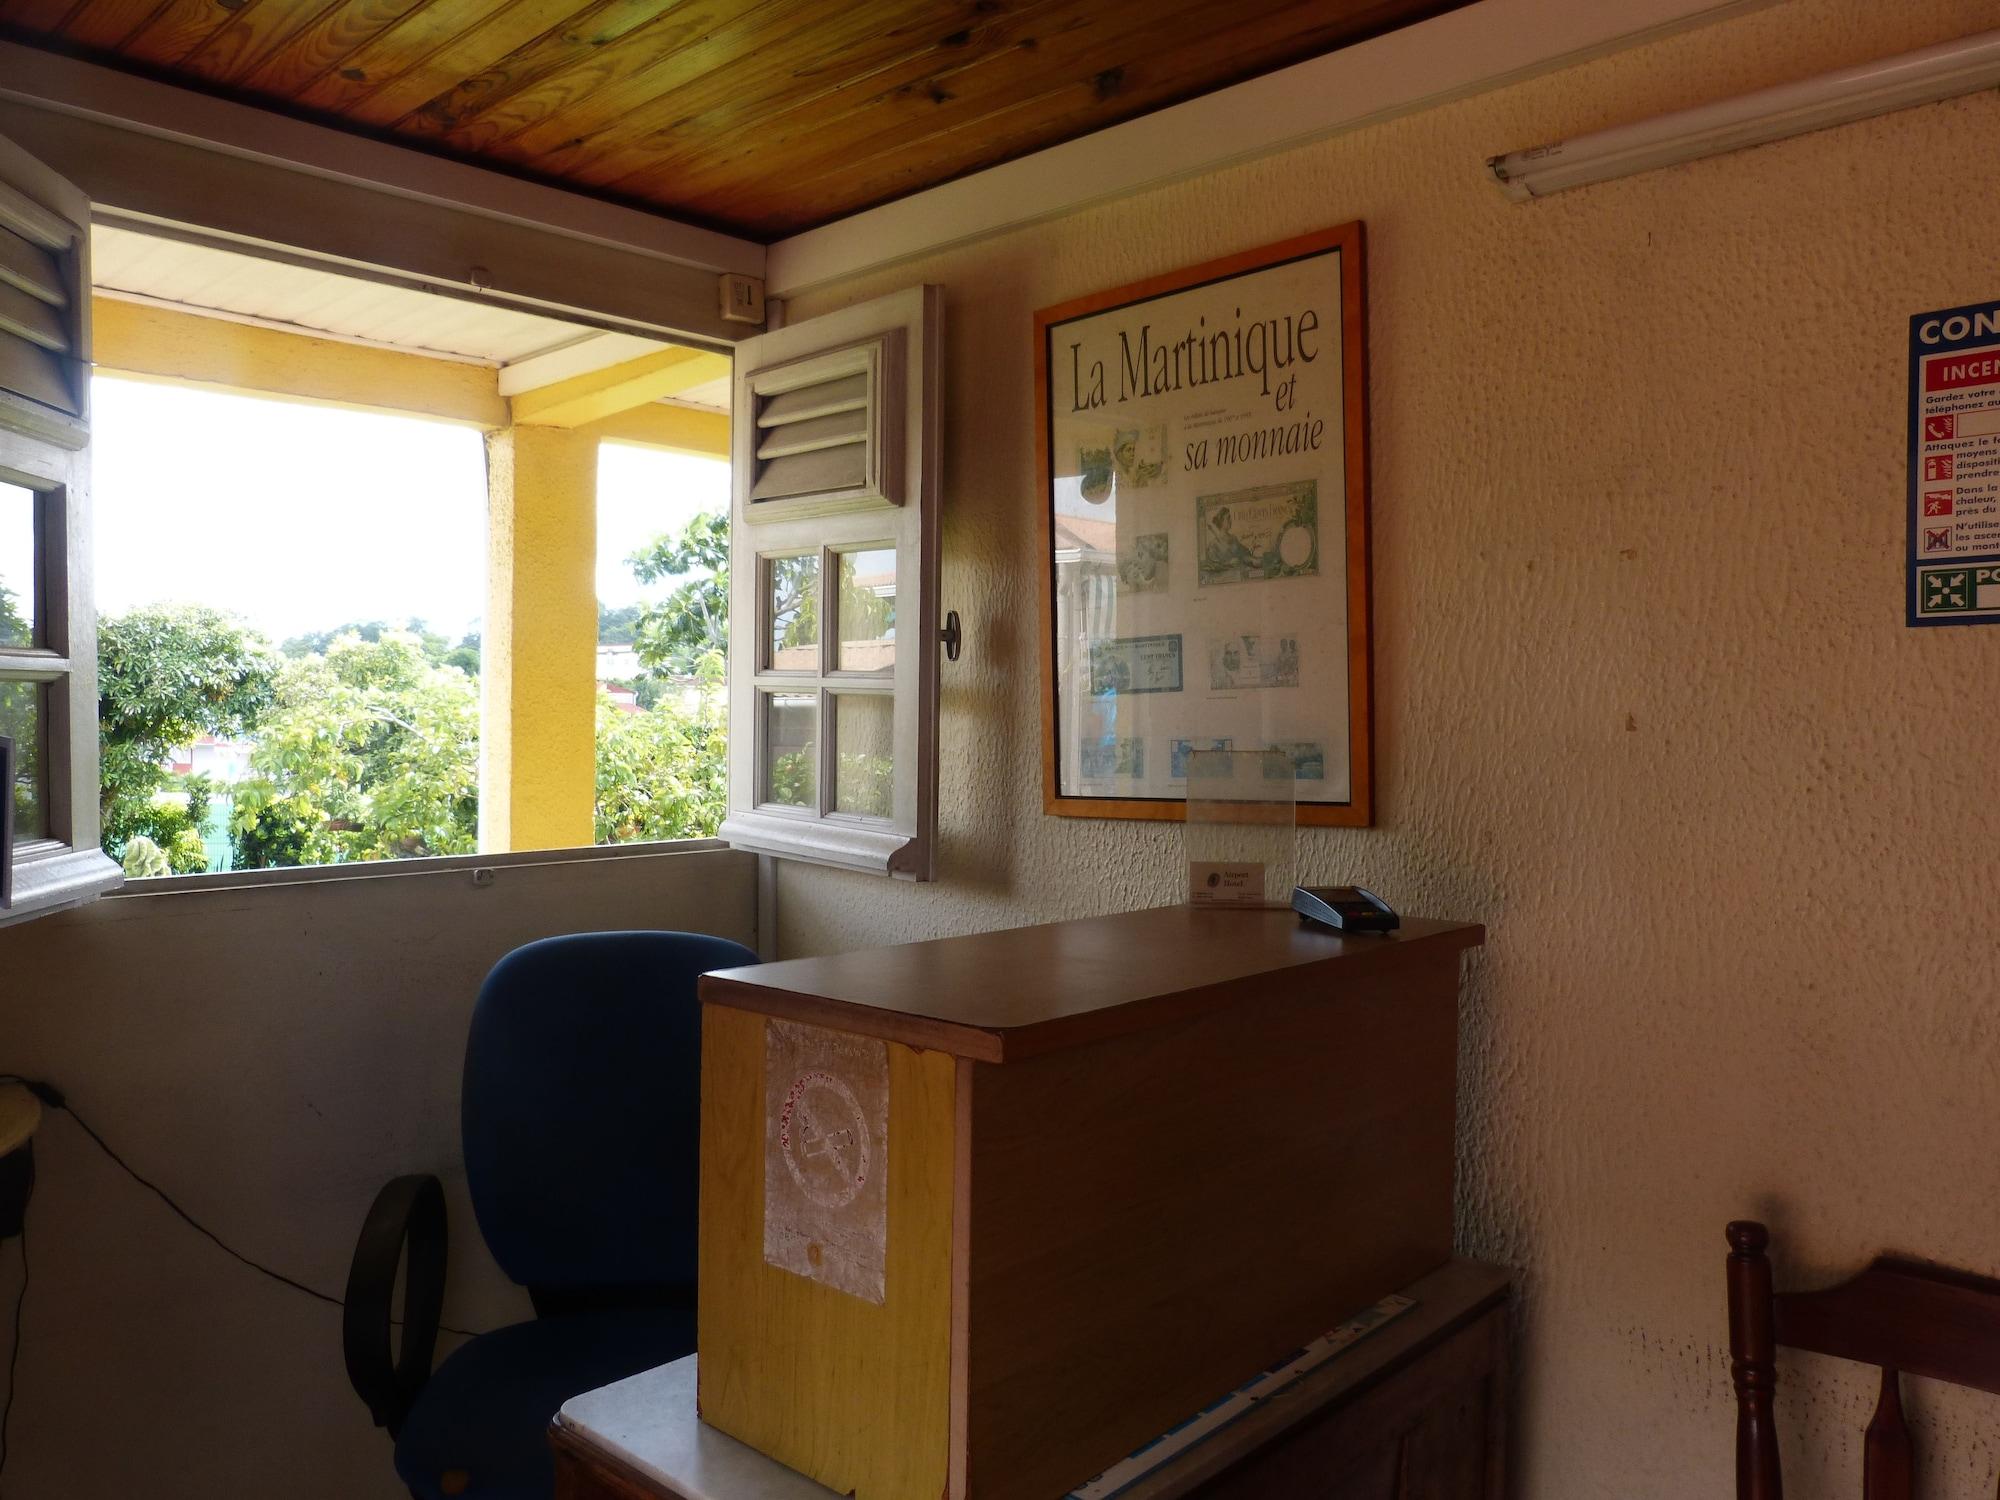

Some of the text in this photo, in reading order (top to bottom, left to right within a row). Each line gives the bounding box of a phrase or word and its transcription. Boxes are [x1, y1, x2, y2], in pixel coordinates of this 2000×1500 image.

[1919, 310, 2000, 345] CON
[1070, 307, 1319, 412] La Martinique
[1276, 373, 1297, 412] et
[1926, 389, 1995, 404] Gardez votre
[1925, 402, 1984, 414] téléphonez
[1184, 435, 1208, 471] sa
[1217, 412, 1323, 466] monnaie
[1925, 441, 1974, 452] Attaquez
[1978, 438, 1988, 446] le
[1956, 449, 1997, 459] moyens
[1956, 469, 1999, 481] prendre
[1956, 484, 1998, 495] Dans la
[1955, 496, 1996, 505] chaleur,
[1956, 507, 1979, 518] près
[1955, 533, 1970, 541] les
